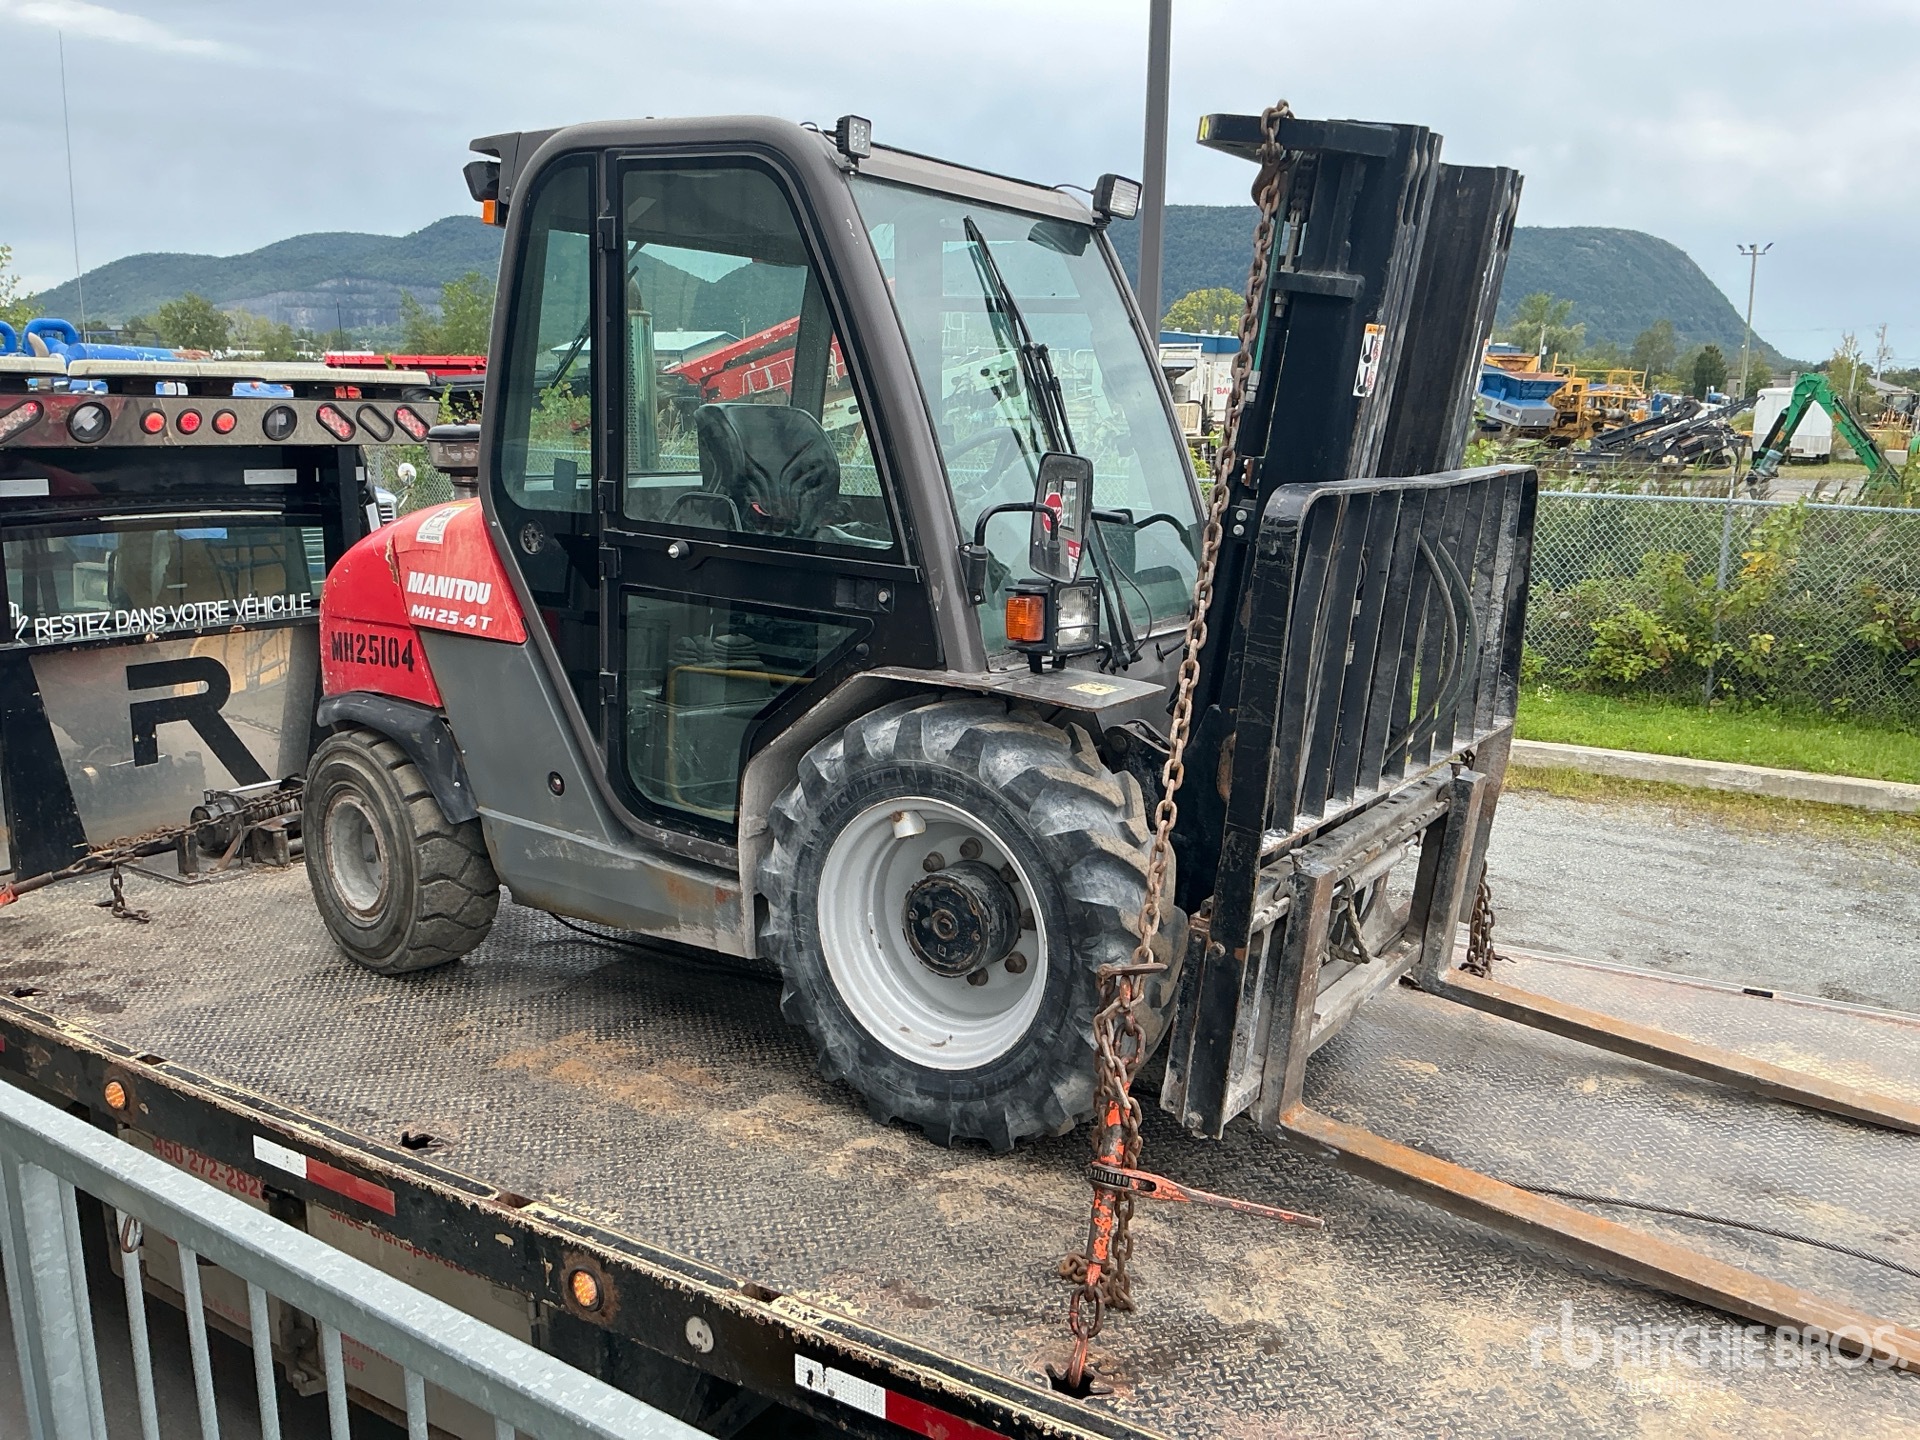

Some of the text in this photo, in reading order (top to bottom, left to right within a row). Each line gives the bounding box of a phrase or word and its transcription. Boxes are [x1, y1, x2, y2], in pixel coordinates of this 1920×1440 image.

[406, 571, 492, 605] MANITOU
[34, 611, 112, 638] RESTEZ
[115, 606, 166, 630] DANS
[169, 599, 230, 623] VOTRE
[232, 593, 312, 617] VÉHICULE
[330, 631, 415, 672] MH25104
[152, 1136, 184, 1165] 450
